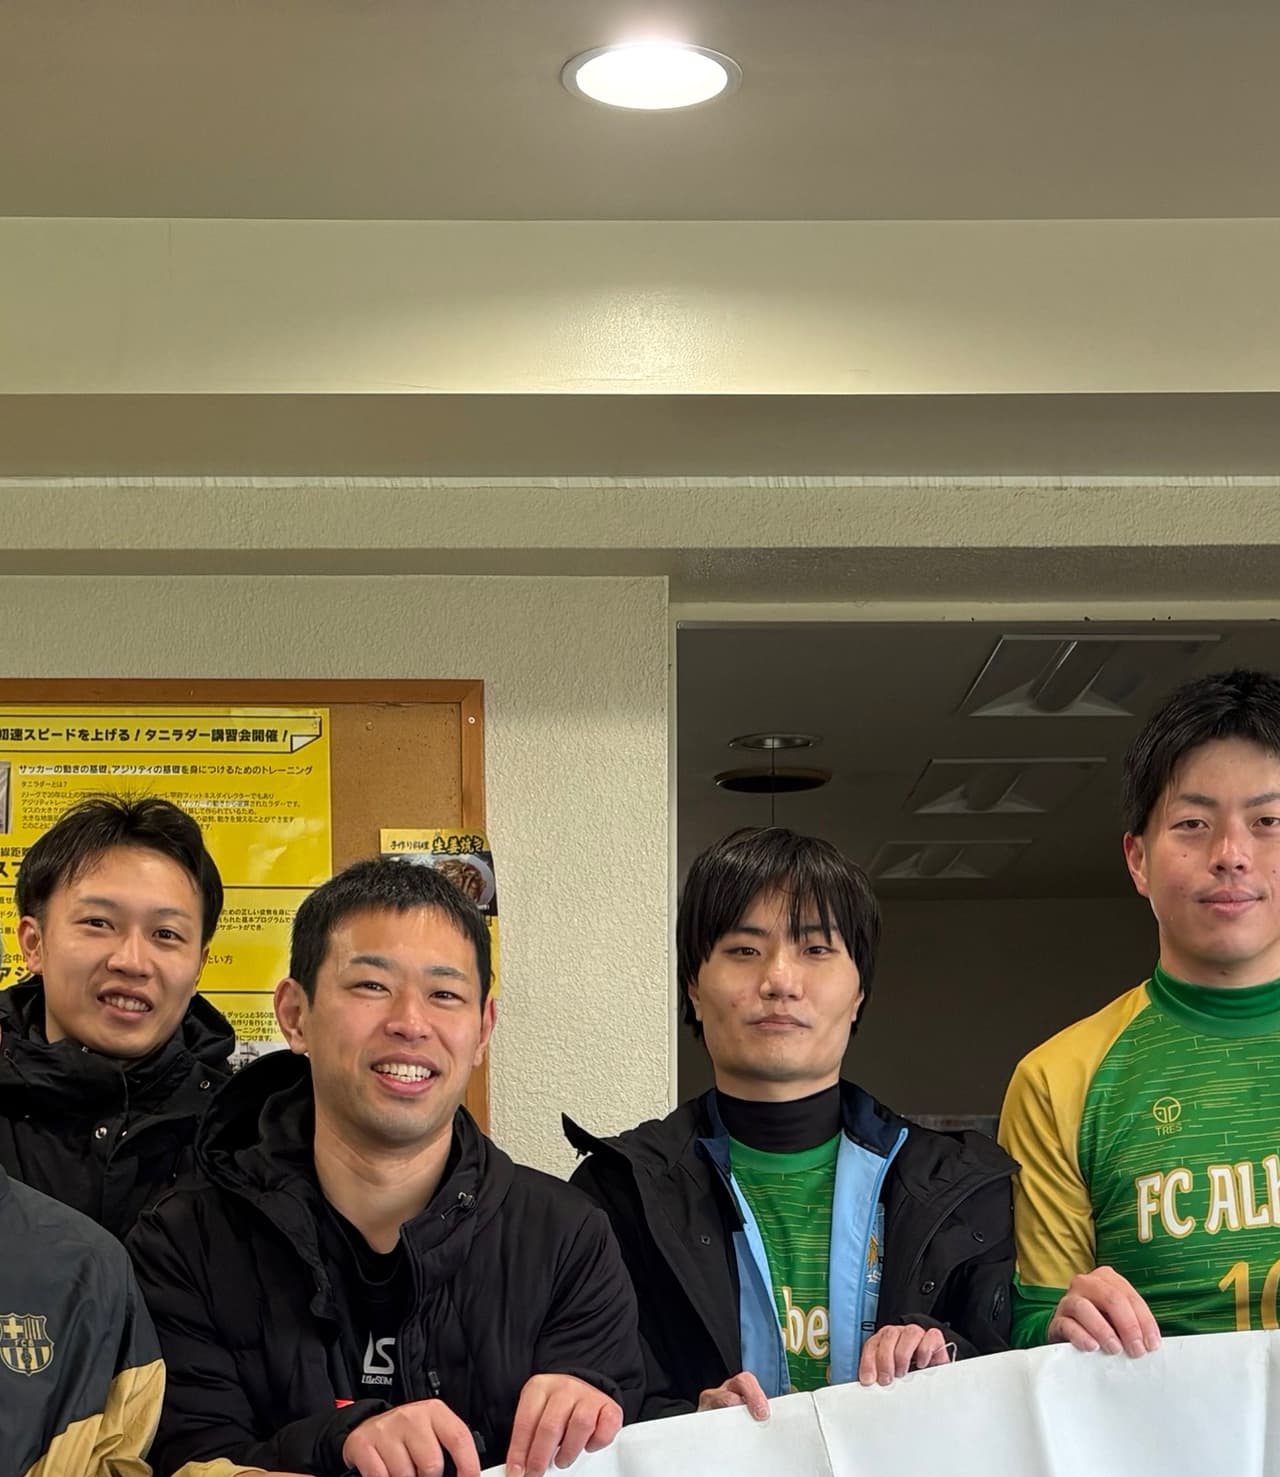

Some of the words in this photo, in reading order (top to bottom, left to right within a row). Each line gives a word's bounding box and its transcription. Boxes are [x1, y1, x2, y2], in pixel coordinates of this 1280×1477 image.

[1155, 1125, 1183, 1137] TRES
[1135, 1168, 1196, 1243] FC
[781, 1286, 830, 1357] be
